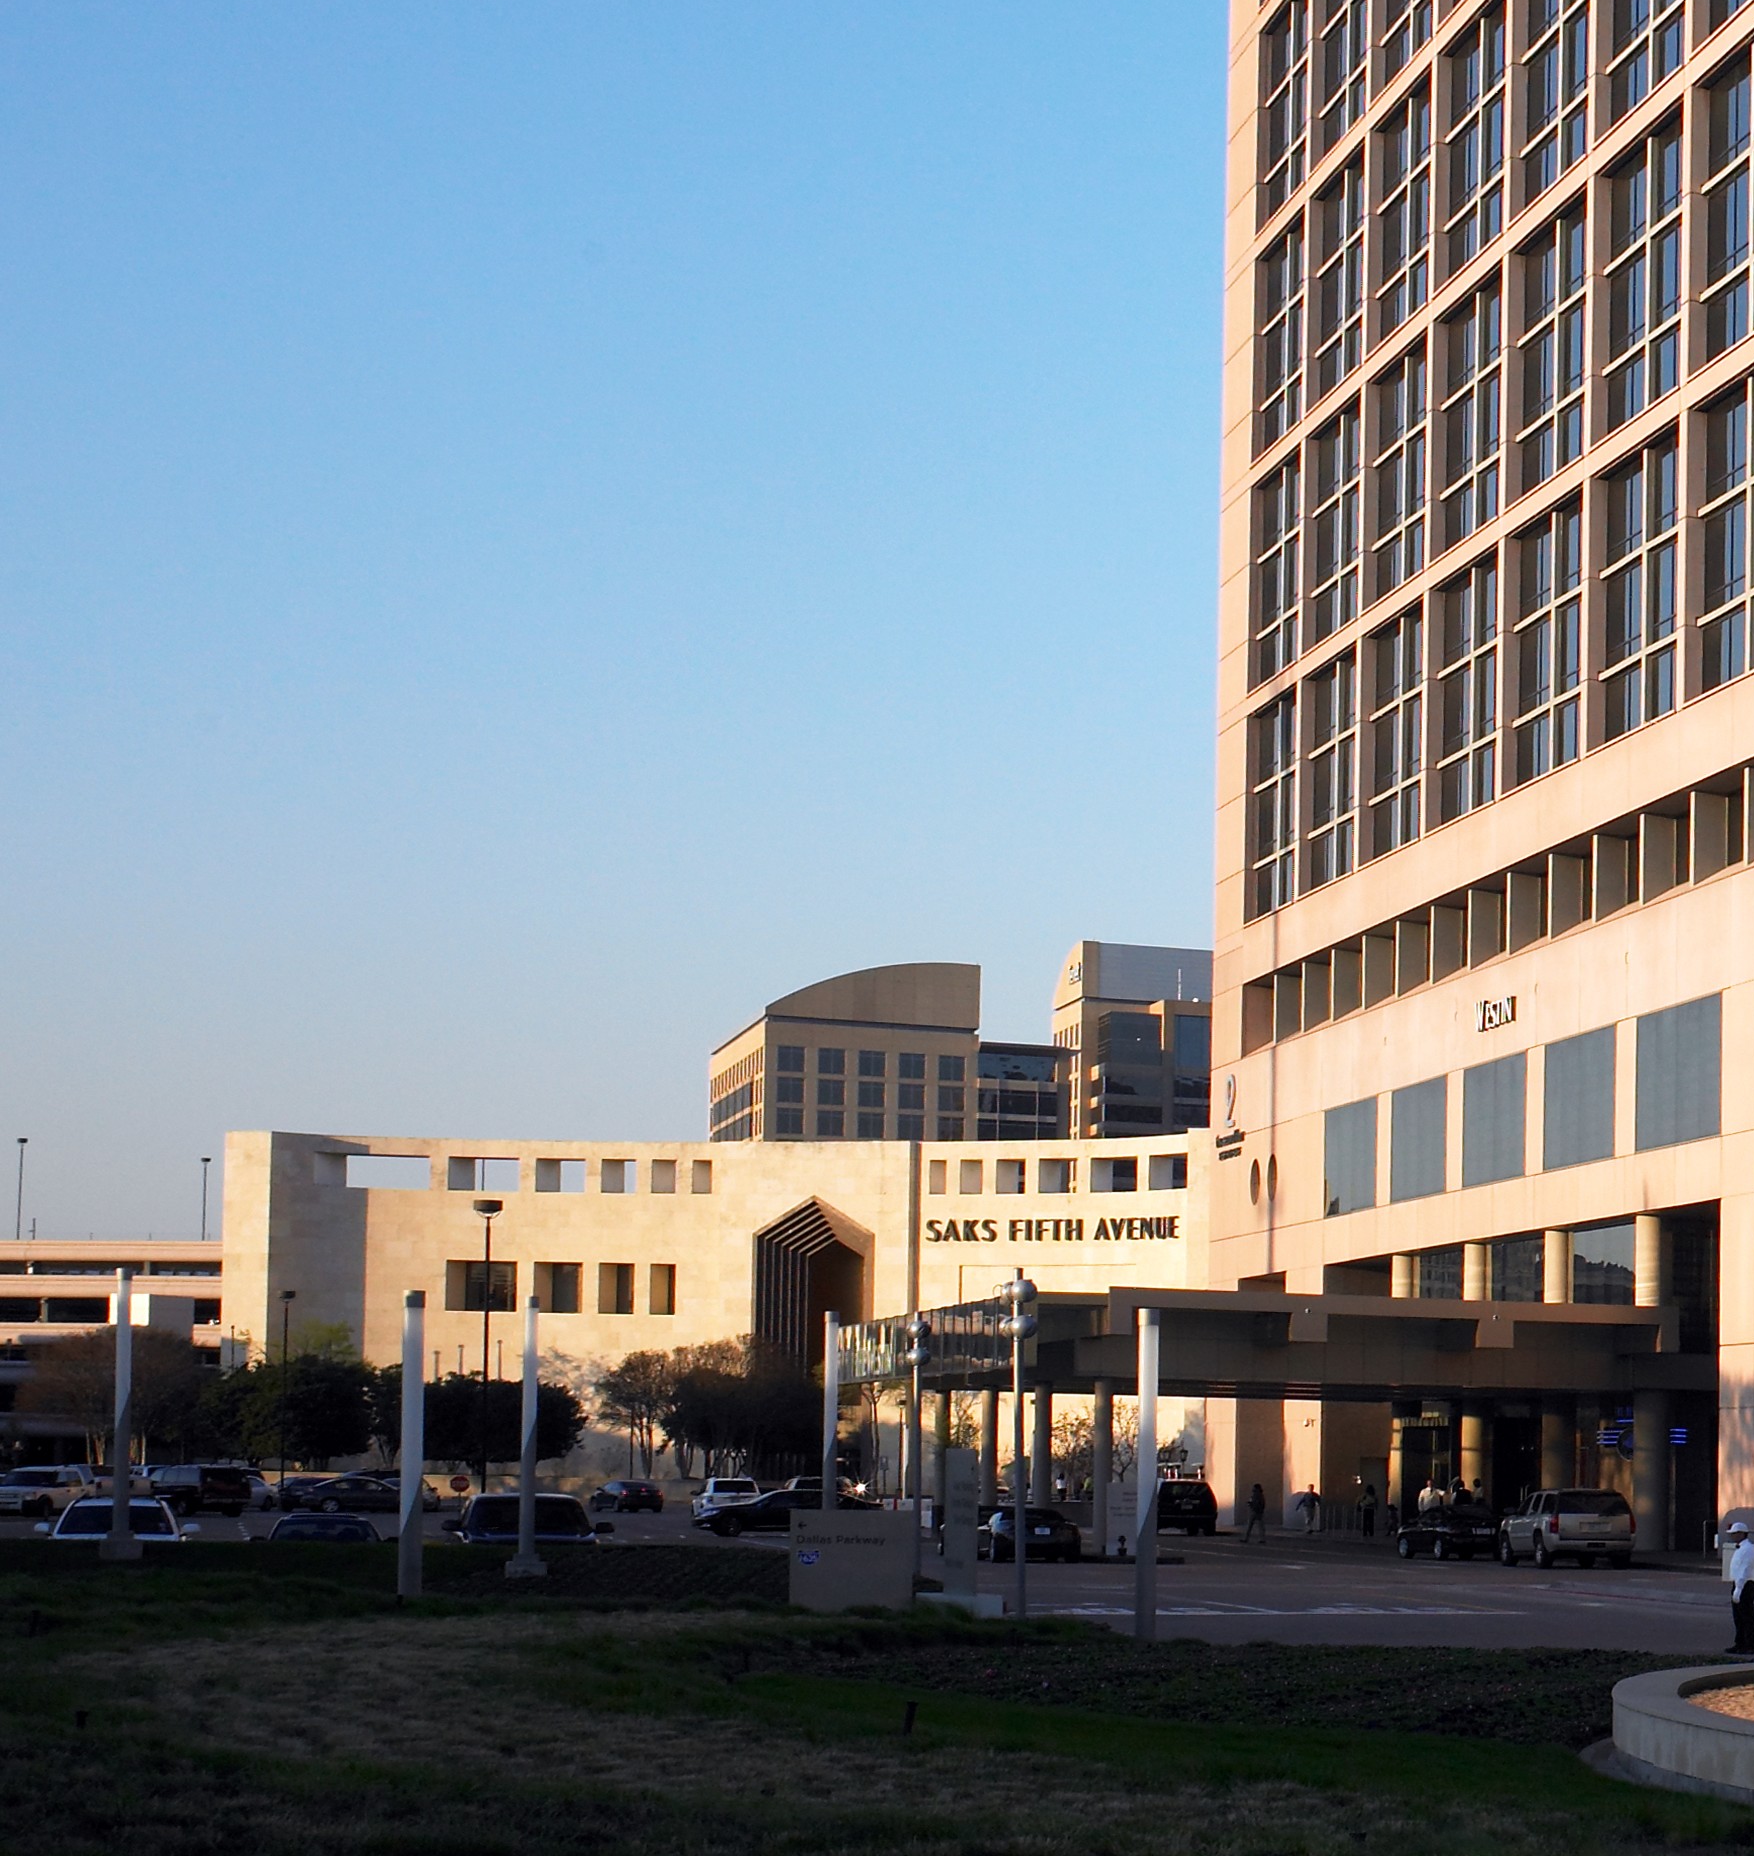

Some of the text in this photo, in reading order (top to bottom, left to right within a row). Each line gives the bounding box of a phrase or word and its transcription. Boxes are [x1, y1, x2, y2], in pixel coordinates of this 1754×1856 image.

[925, 1216, 1180, 1242] SAKS FIFTH AVENUE
[796, 1535, 886, 1546] Dallas Parkway
